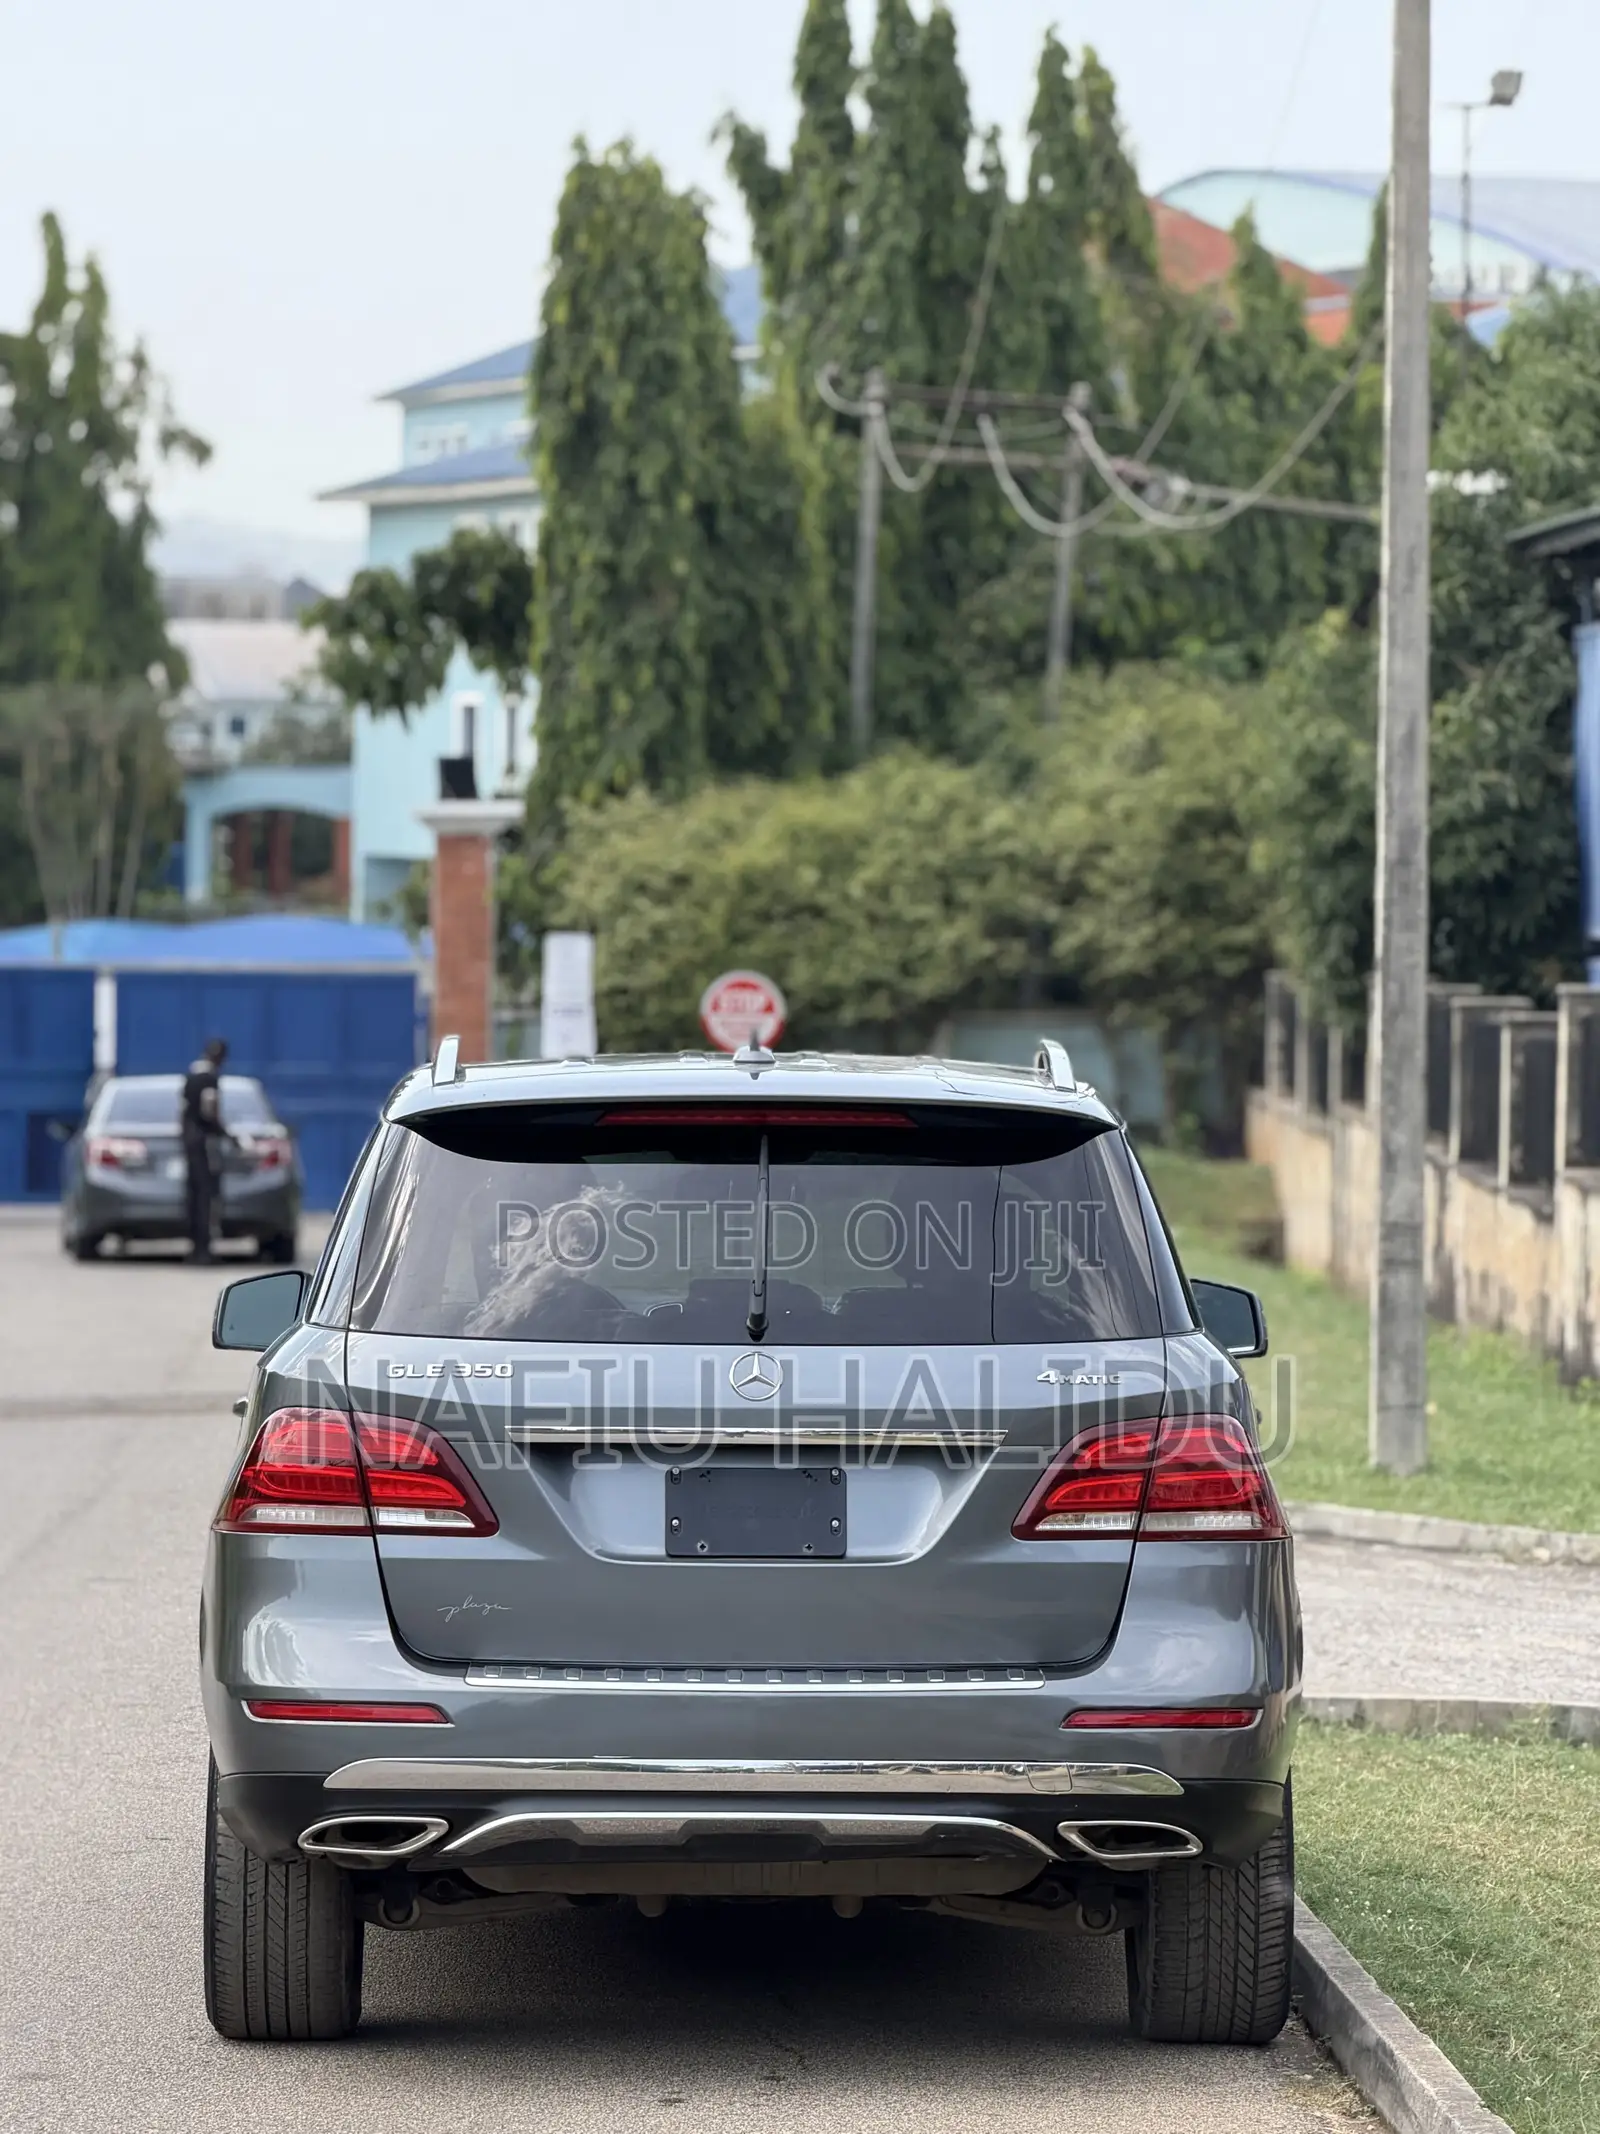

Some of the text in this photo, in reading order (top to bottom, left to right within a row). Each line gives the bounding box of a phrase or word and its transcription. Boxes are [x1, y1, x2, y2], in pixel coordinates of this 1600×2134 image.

[386, 1363, 515, 1378] GLE 350
[1036, 1370, 1123, 1385] 4MATIC
